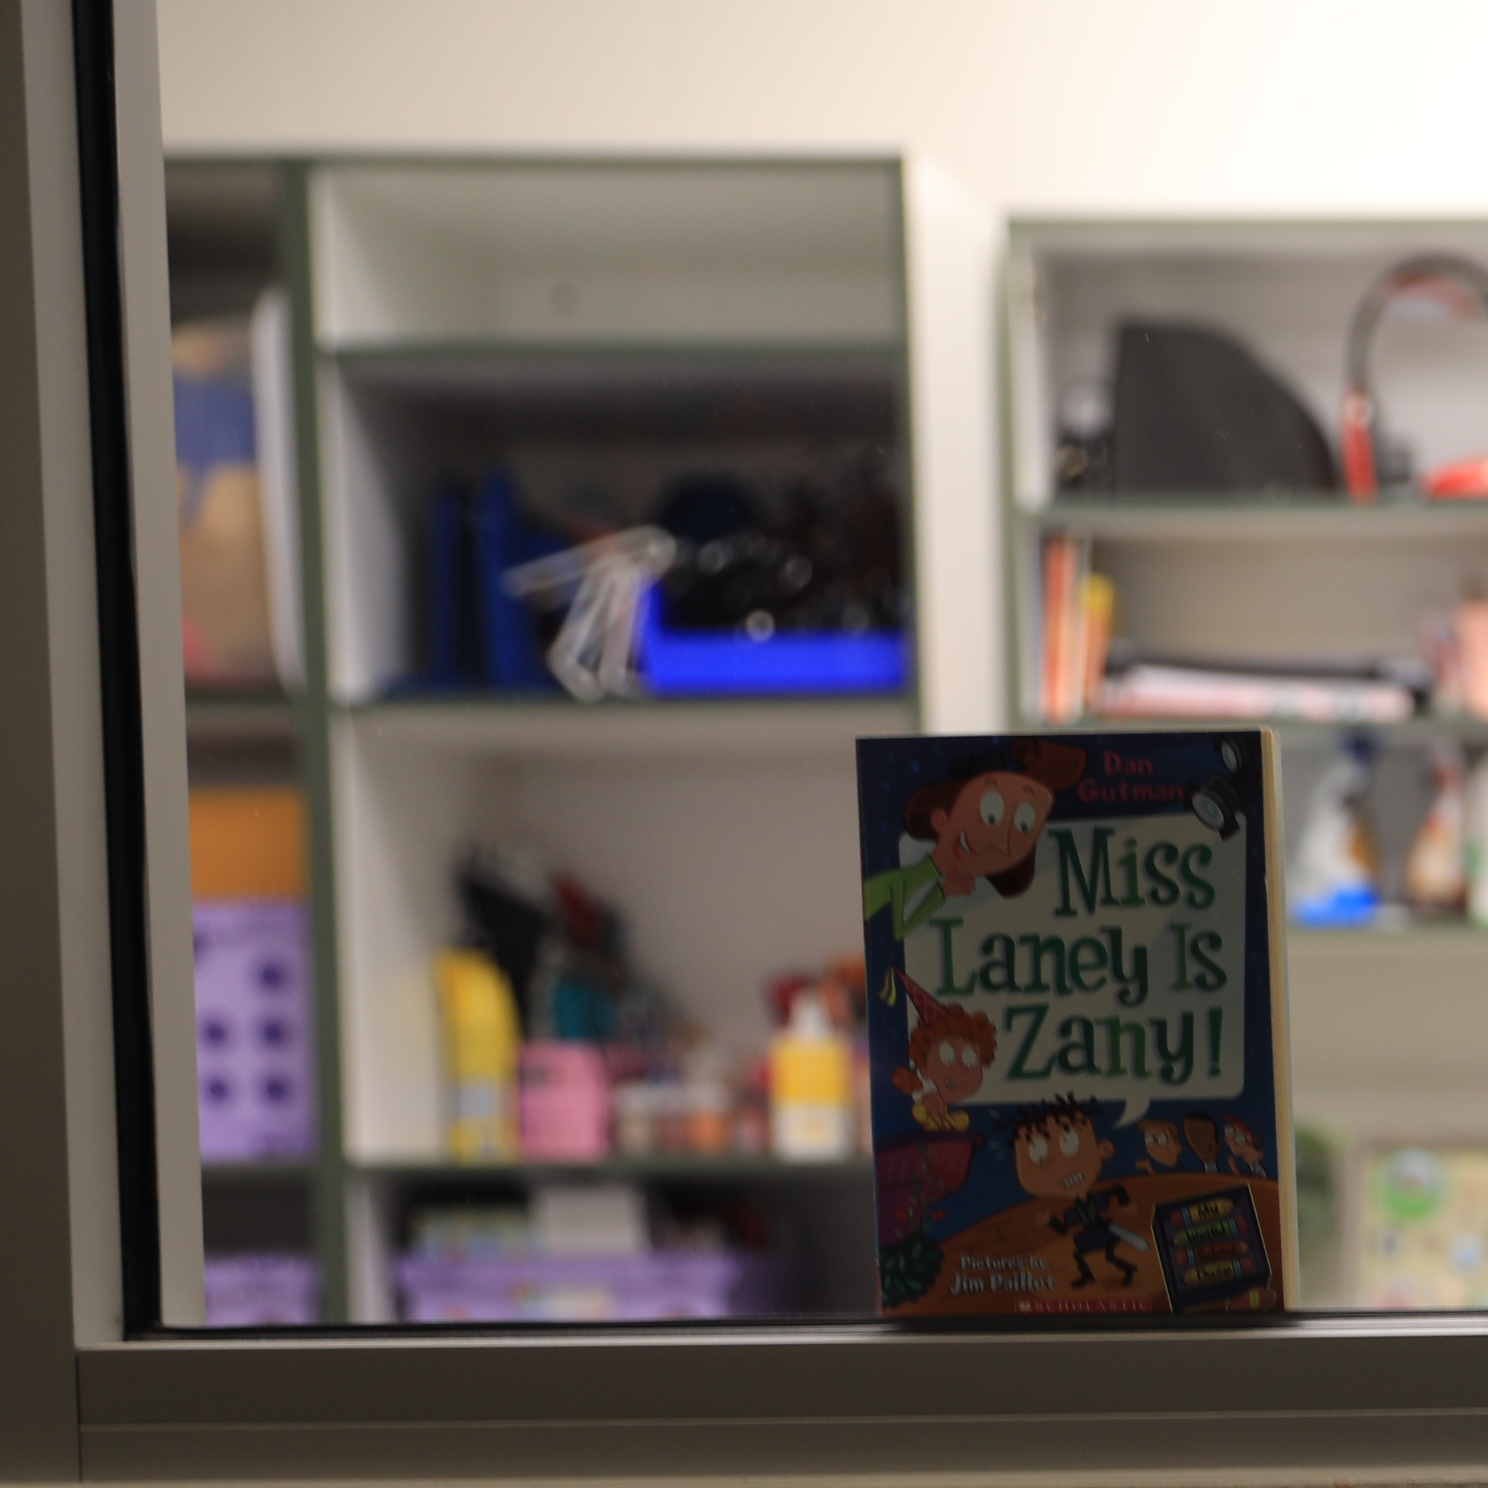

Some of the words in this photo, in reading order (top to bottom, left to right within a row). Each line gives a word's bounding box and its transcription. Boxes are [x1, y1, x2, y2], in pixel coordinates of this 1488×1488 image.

[1103, 749, 1155, 778] Dan
[1077, 776, 1185, 805] Gutman
[1047, 825, 1217, 918] Miss
[928, 917, 1149, 1007] Laney
[1169, 922, 1228, 992] Is
[1004, 1003, 1223, 1085] Zany!
[1197, 1201, 1220, 1222] My
[960, 1253, 1025, 1271] Pictures
[1030, 1254, 1047, 1272] by
[947, 1271, 985, 1297] Jim
[989, 1271, 1056, 1294] Paillot
[1034, 1300, 1149, 1314] SCHOLASTIC
